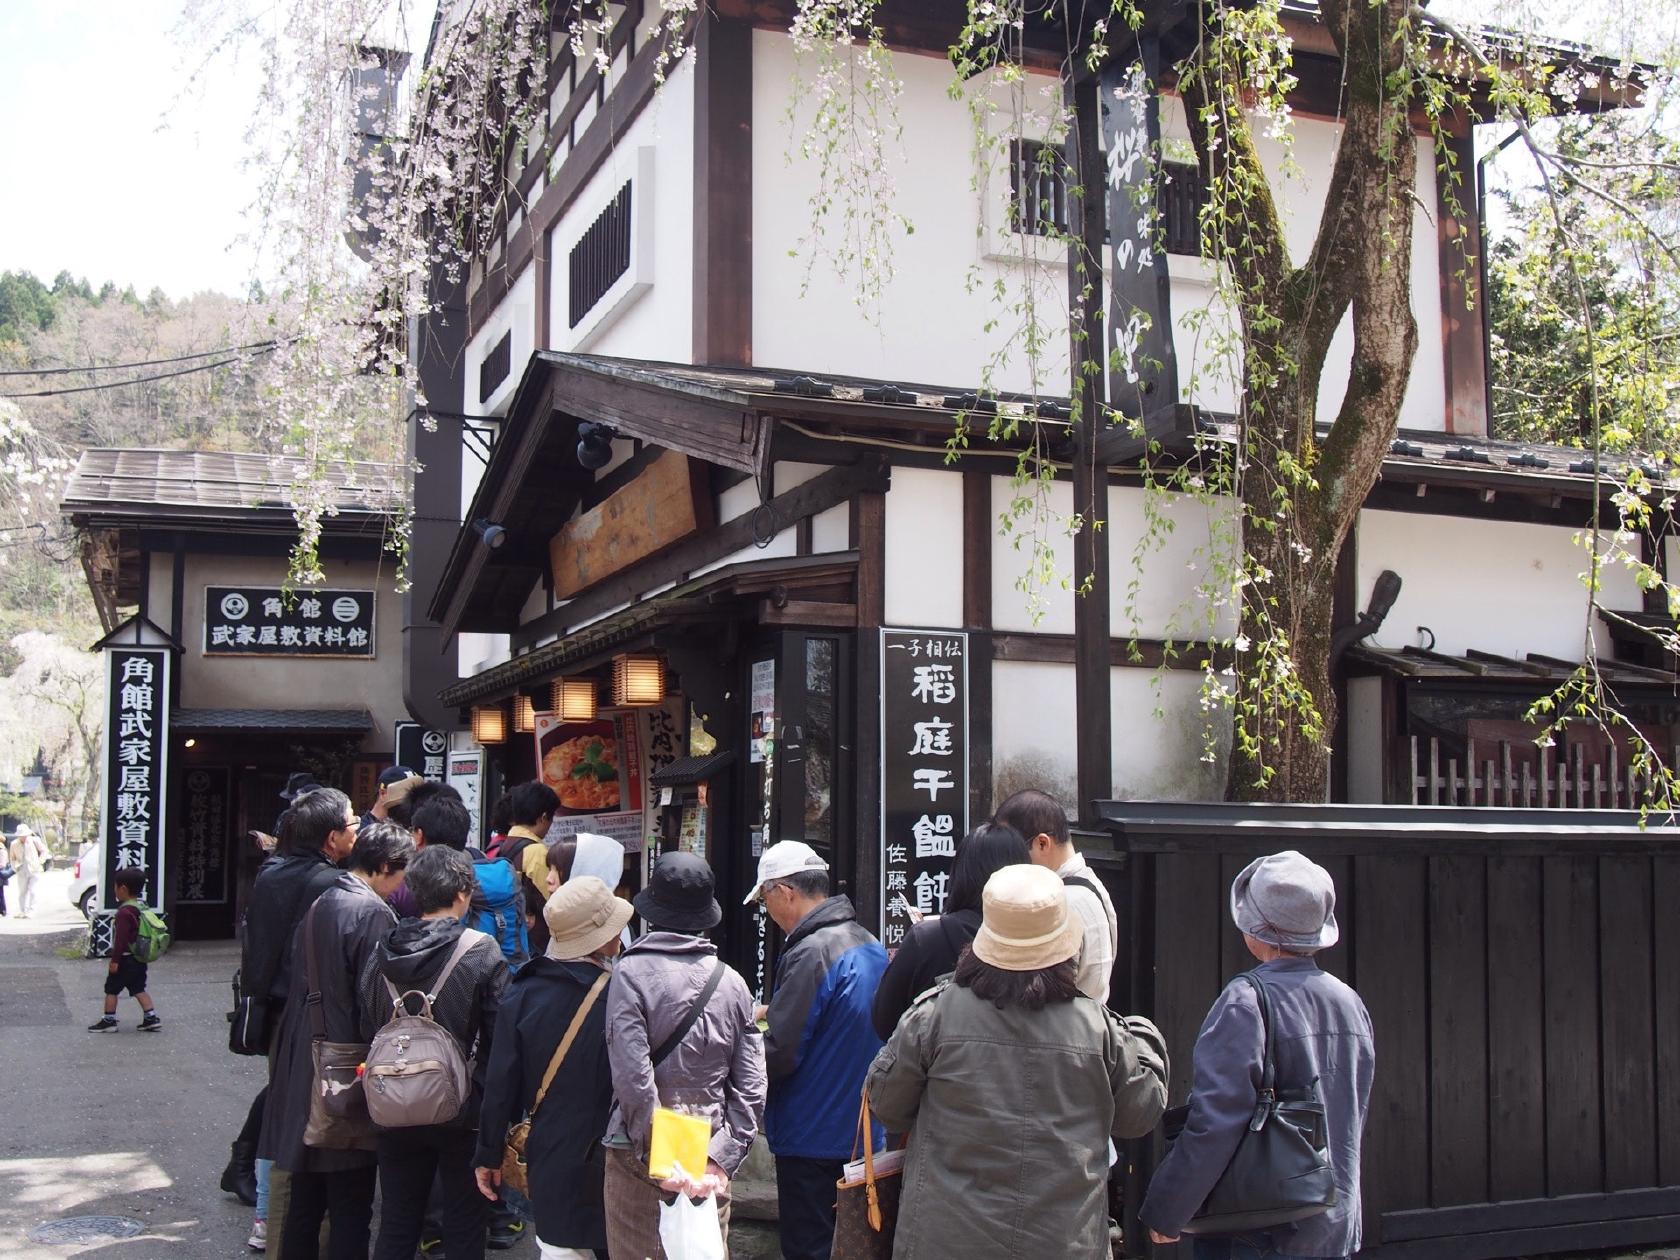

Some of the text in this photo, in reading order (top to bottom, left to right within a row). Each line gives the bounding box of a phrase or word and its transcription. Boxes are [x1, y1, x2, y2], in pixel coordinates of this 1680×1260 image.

[262, 597, 322, 619] 角館
[211, 624, 368, 647] 武家屋敷資料館
[887, 639, 962, 658] 一子相伝
[115, 657, 154, 905] 角館武家屋敷資料
[886, 843, 908, 944] 佐藤養悦
